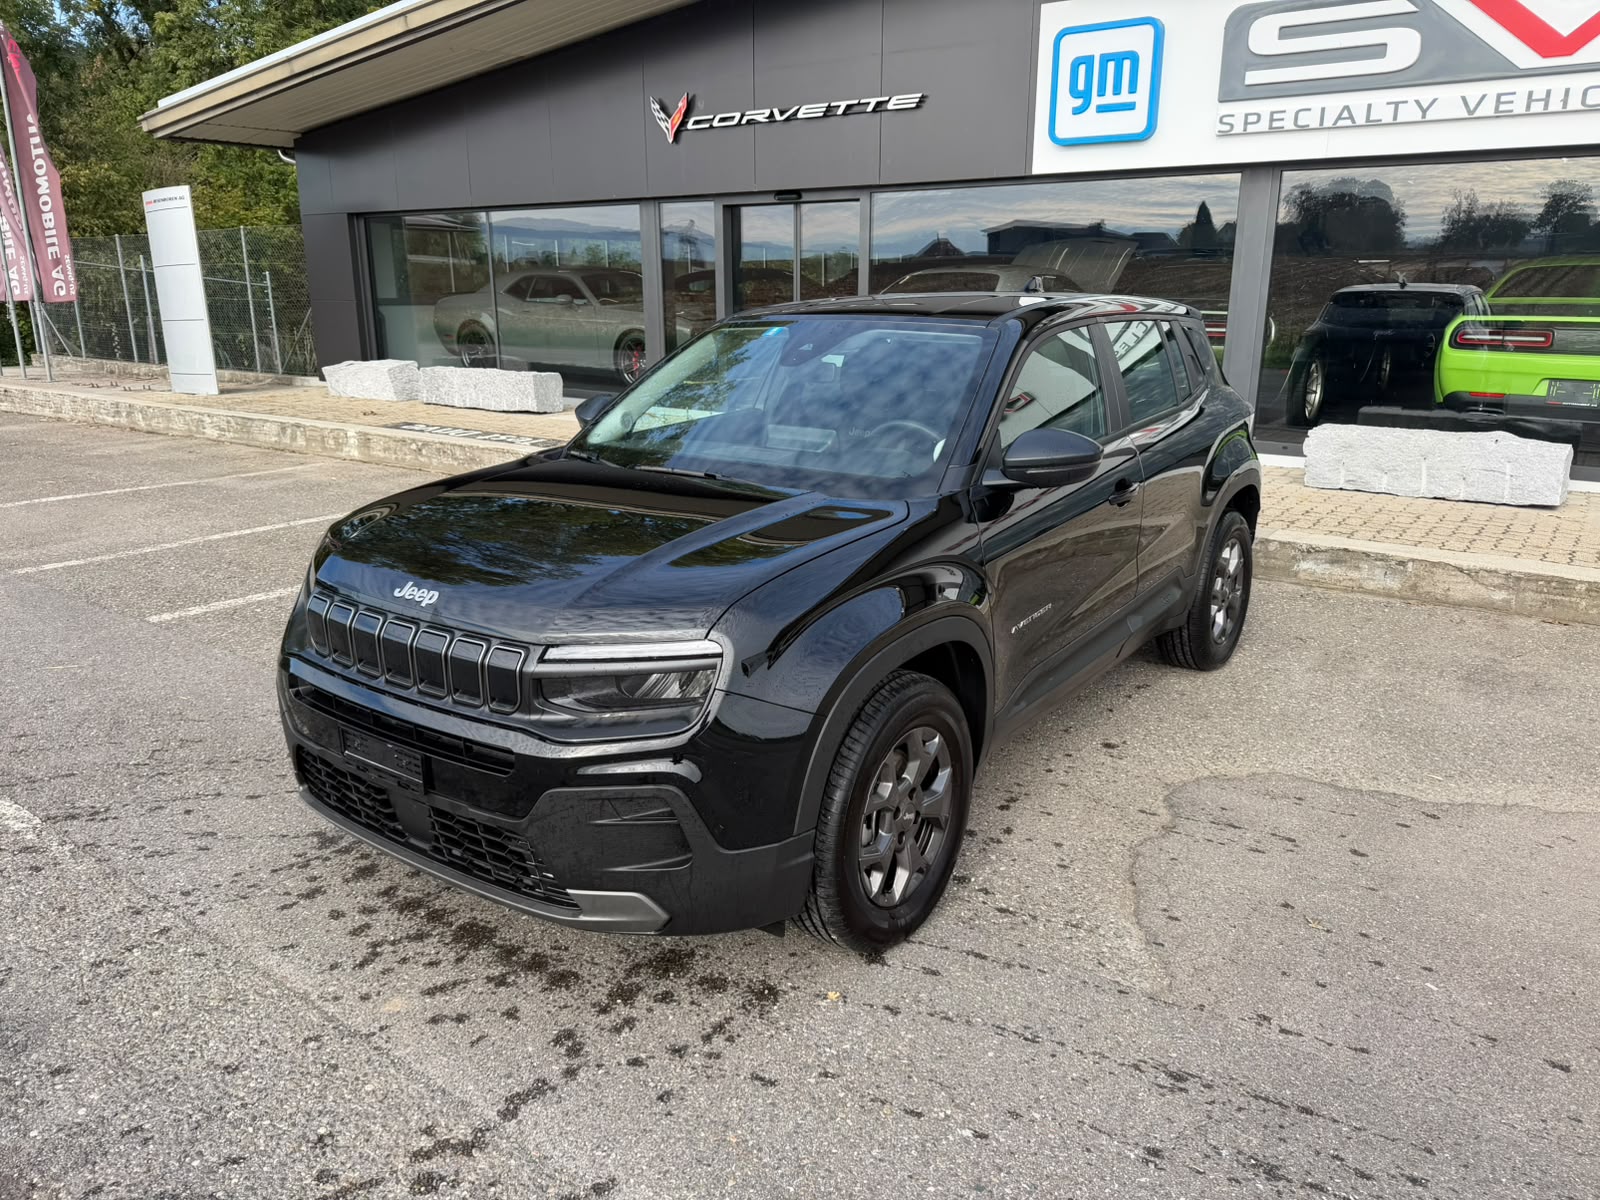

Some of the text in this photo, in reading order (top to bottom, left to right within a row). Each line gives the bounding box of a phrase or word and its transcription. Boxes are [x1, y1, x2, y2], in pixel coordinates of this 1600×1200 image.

[1069, 50, 1140, 115] gm
[686, 92, 923, 130] CORVETTE
[1217, 97, 1440, 135] SPECIALTY
[393, 581, 440, 607] Jeep
